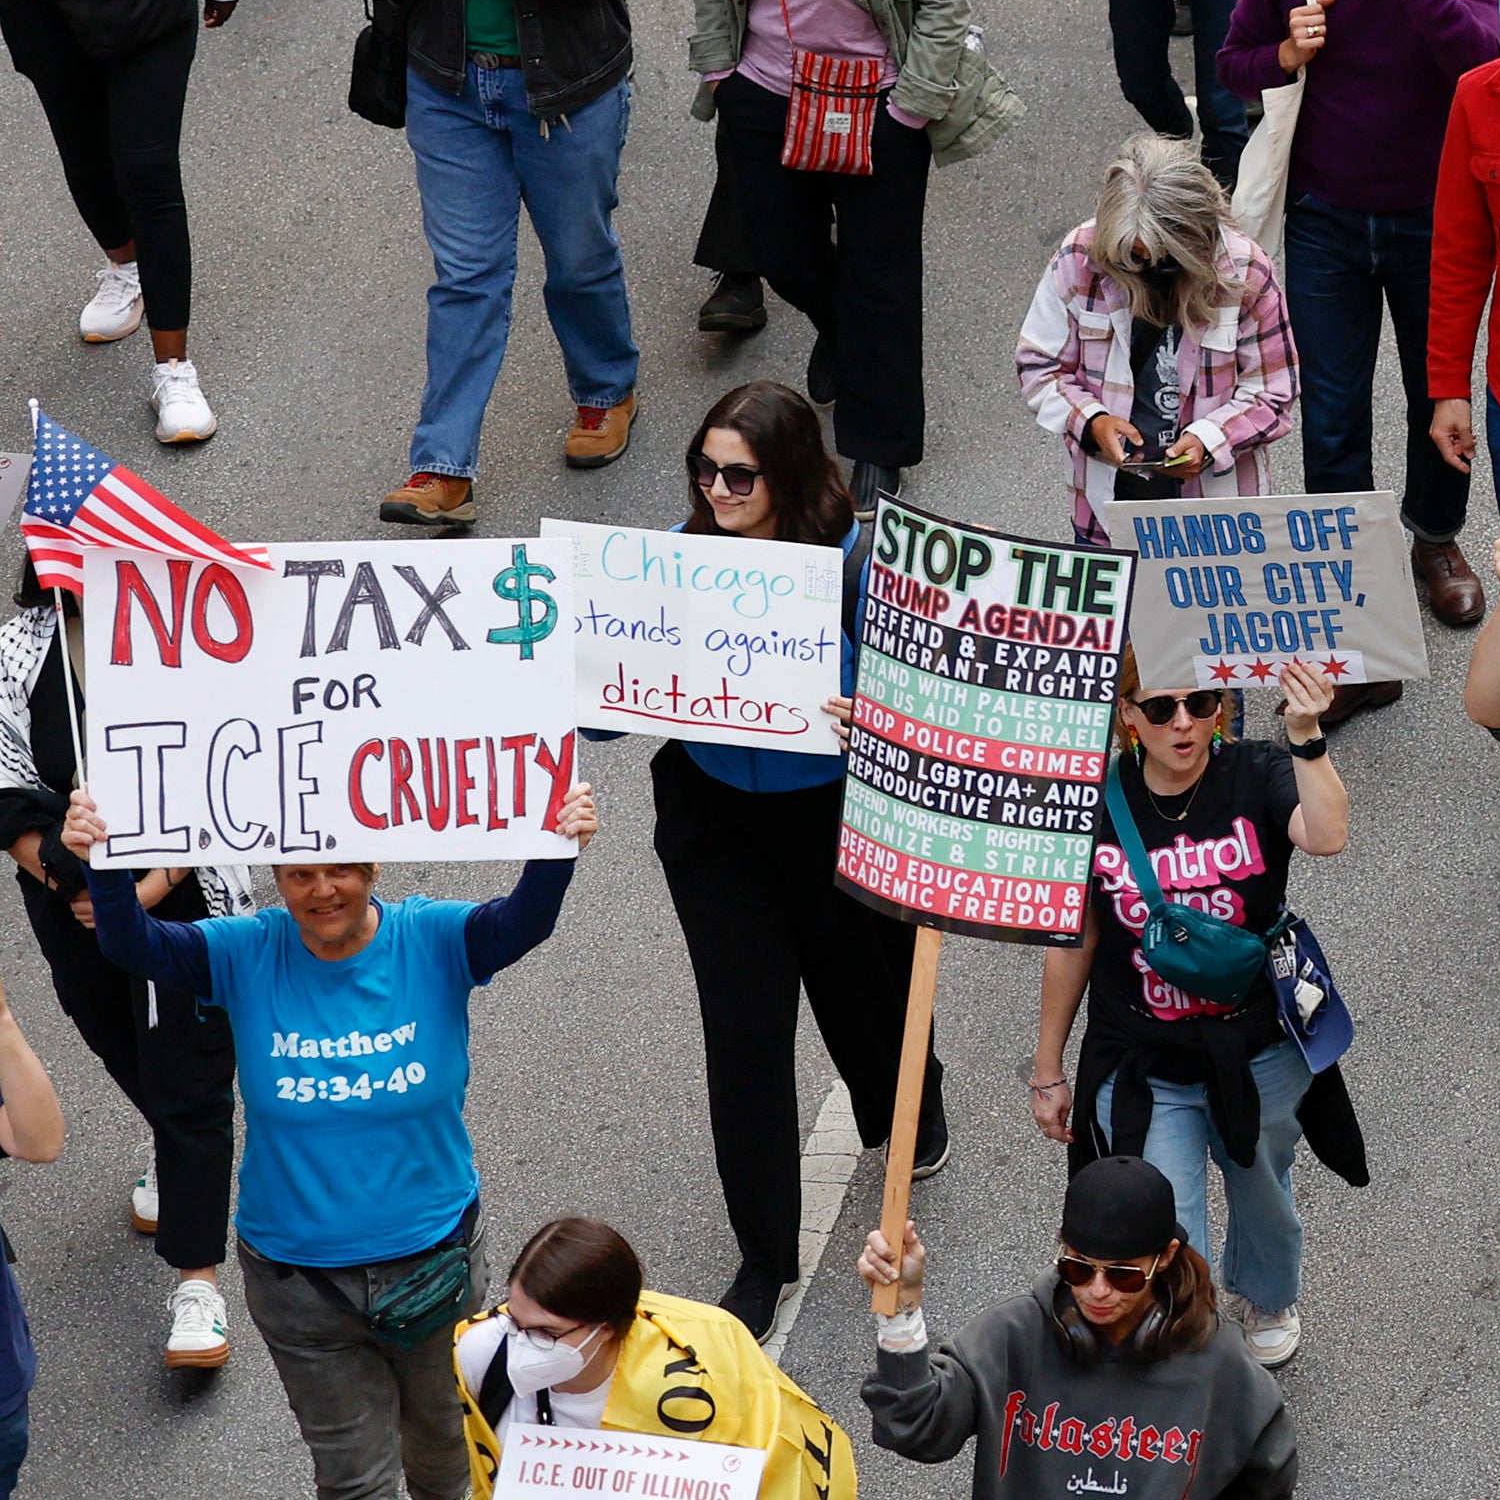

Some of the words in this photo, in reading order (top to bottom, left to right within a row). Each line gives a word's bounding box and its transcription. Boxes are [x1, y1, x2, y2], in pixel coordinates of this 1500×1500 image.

[1133, 512, 1266, 559] HANDS
[1286, 507, 1359, 552] OFF
[602, 532, 795, 619] Chicago
[1165, 566, 1247, 609] OUR
[1263, 560, 1366, 608] CITY,
[111, 560, 253, 668] NO
[284, 559, 470, 657] TAX
[487, 543, 558, 661] $
[705, 618, 837, 677] against
[1200, 609, 1343, 655] JAGOFF
[293, 674, 381, 713] FOR
[602, 664, 809, 729] dictators
[105, 718, 336, 857] I.C.E.
[349, 730, 577, 832] CRUELTY
[271, 1022, 418, 1060] Matthew
[276, 1064, 426, 1102] 25:34-40
[1066, 1467, 1128, 1494] فلسطين
